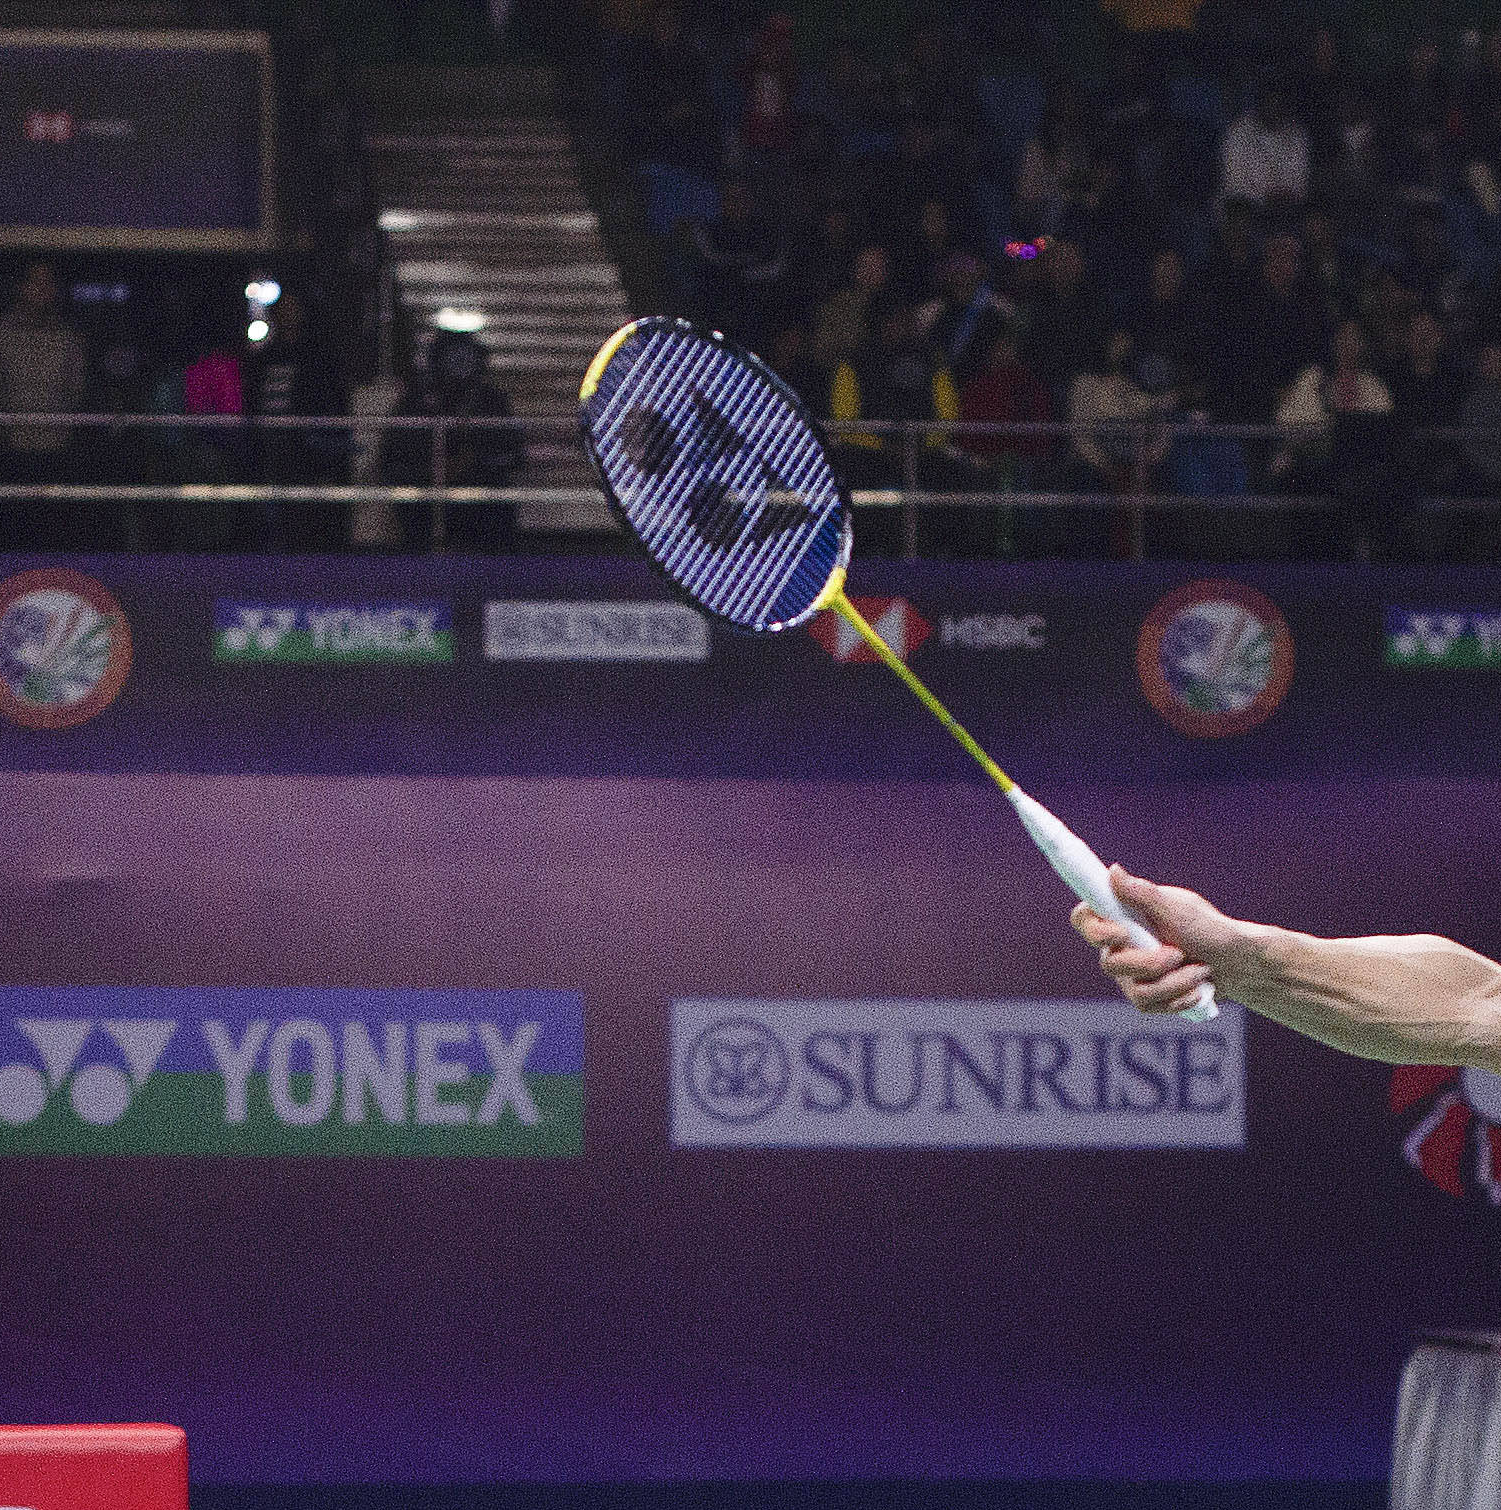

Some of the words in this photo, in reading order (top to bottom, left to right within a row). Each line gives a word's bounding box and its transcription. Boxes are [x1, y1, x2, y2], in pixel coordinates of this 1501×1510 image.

[306, 608, 439, 653] YONEX
[941, 614, 1046, 649] HSBC
[202, 1018, 541, 1126] YONEX
[802, 1032, 1228, 1115] SUNRISE
